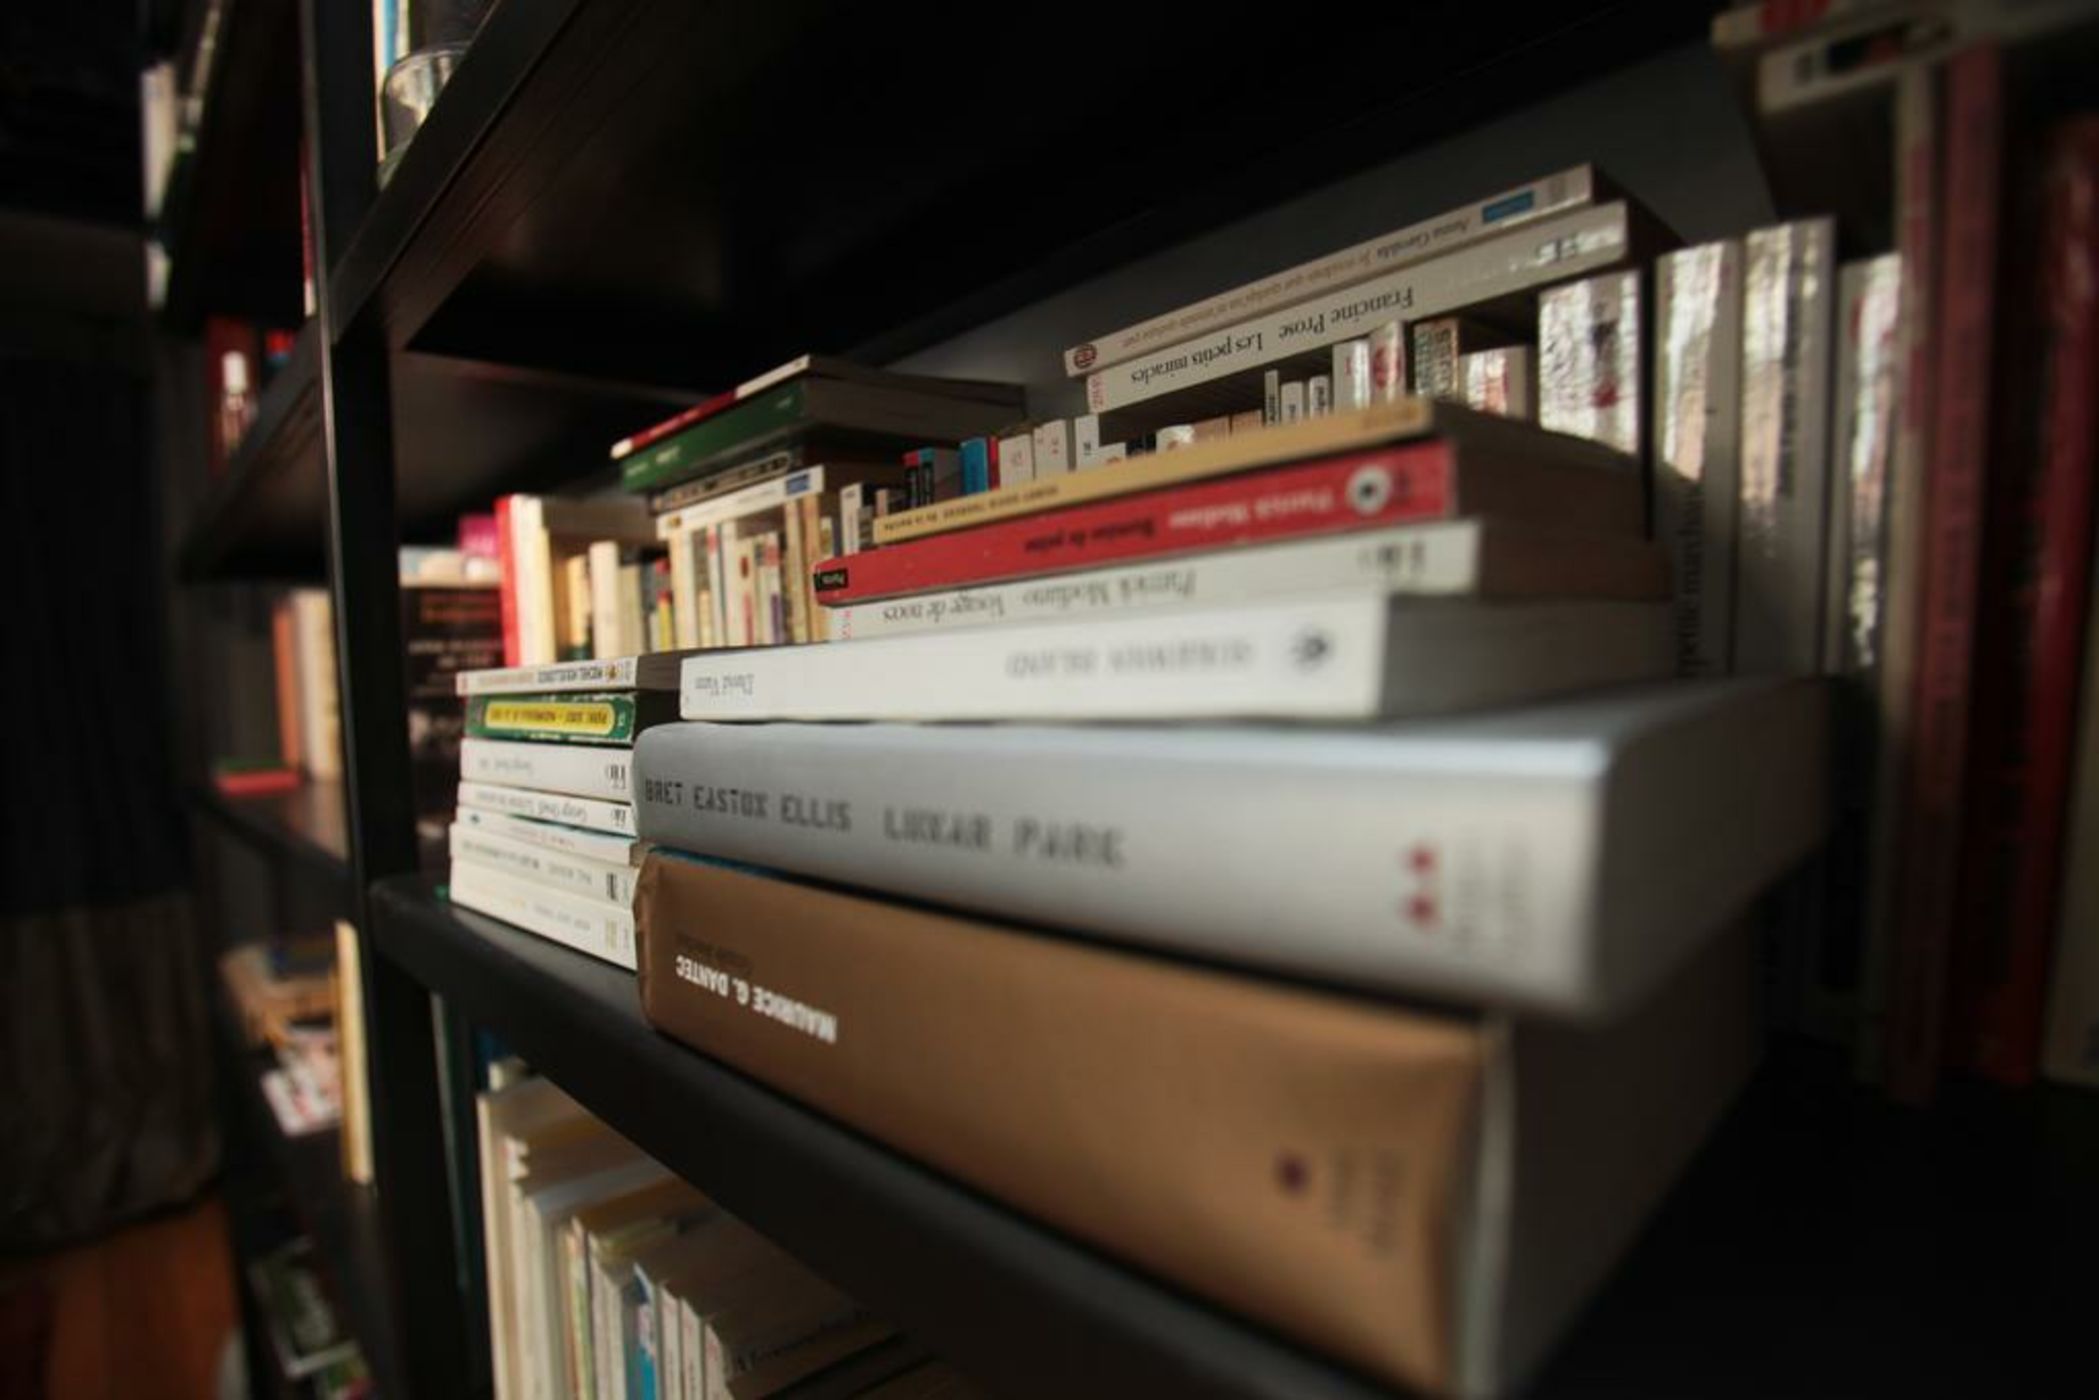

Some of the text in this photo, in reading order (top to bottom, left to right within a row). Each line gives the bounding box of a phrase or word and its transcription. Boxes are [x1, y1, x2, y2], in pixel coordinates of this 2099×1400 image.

[1131, 286, 1414, 384] Francine Prose Les petits miracles
[1119, 567, 1198, 597] Patrick
[882, 601, 925, 623] noces
[925, 600, 946, 623] de
[644, 778, 684, 806] BRET
[780, 794, 853, 832] ELLIS
[674, 953, 839, 1045] MAURICE G. DANTEC
